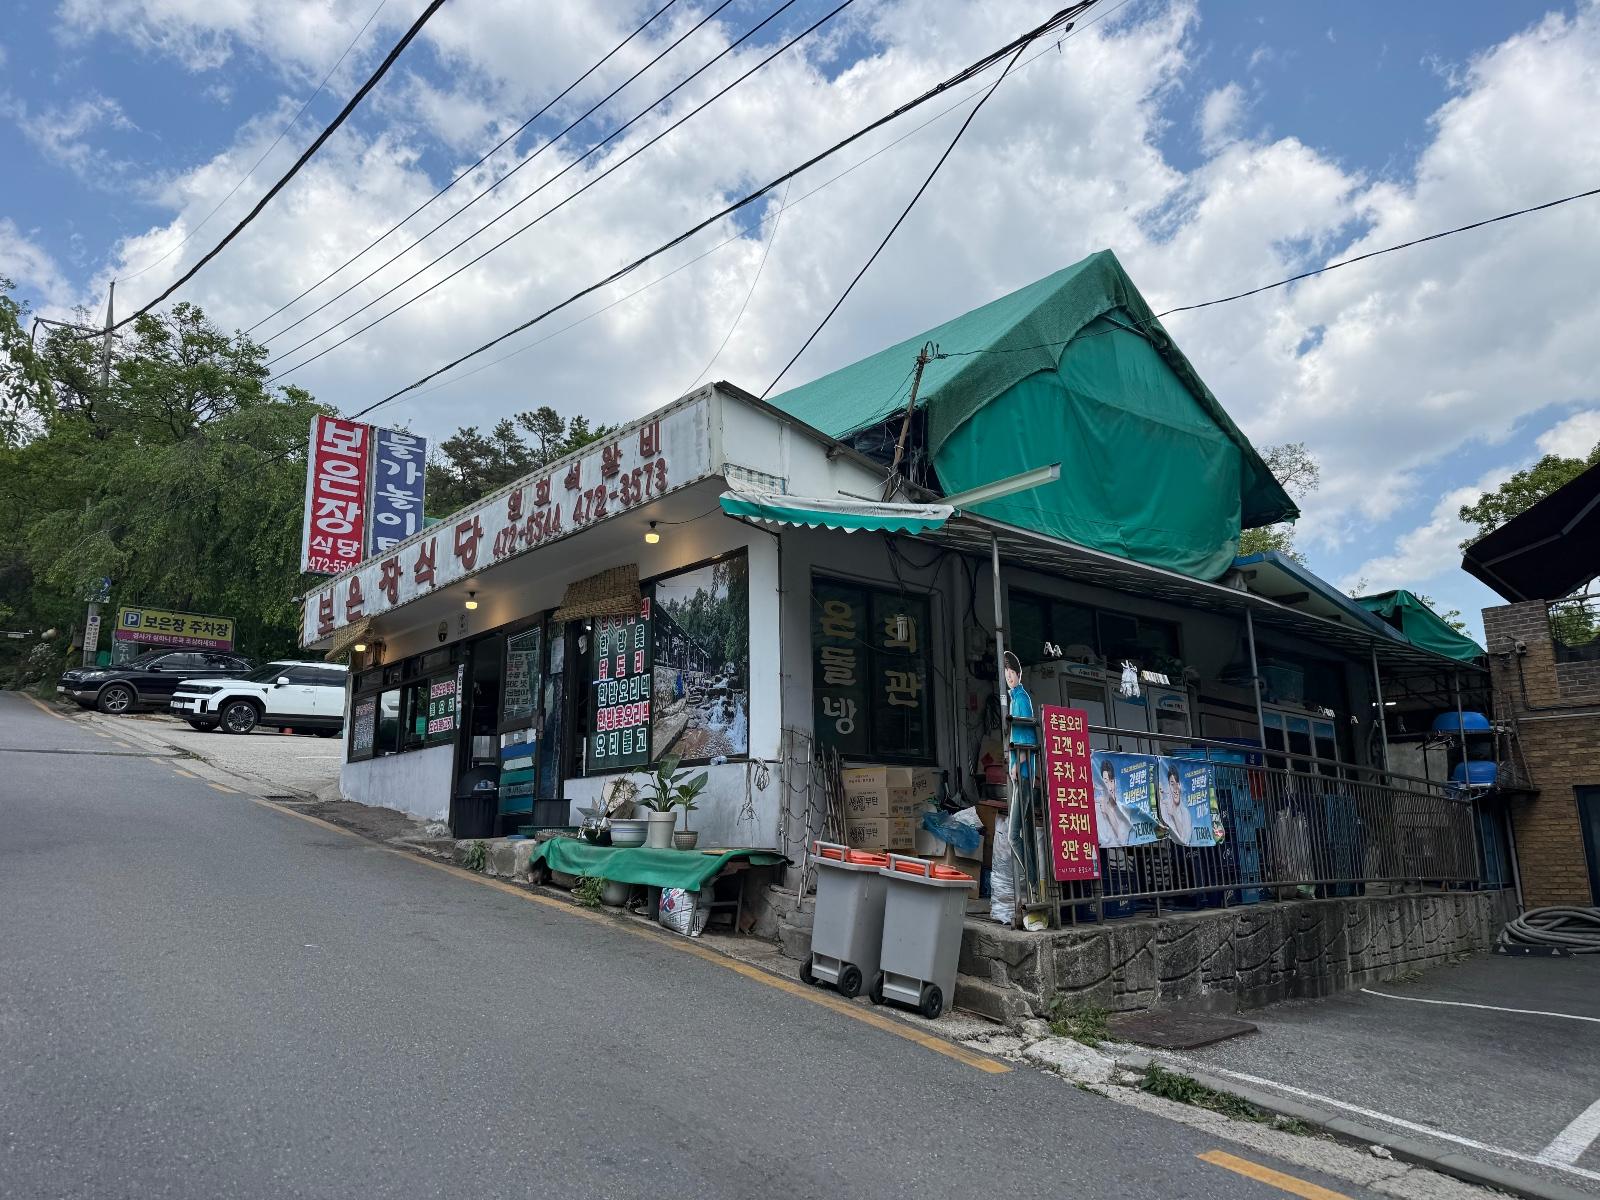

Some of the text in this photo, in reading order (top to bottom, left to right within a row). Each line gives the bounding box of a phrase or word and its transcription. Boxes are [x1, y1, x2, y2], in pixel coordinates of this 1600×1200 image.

[316, 420, 364, 534] 보은장
[492, 457, 668, 560] 472-5544 472-3573
[310, 535, 361, 558] 식당
[308, 556, 358, 574] 472-554
[144, 614, 186, 633] 보은장
[188, 619, 230, 637] 주차장
[1051, 735, 1085, 758] 고객 외
[1053, 761, 1088, 783] 주차 시
[865, 796, 879, 806] 부탄
[1056, 787, 1089, 809] 무조건
[1058, 813, 1091, 835] 주차비
[1061, 838, 1093, 861] 3만 원
